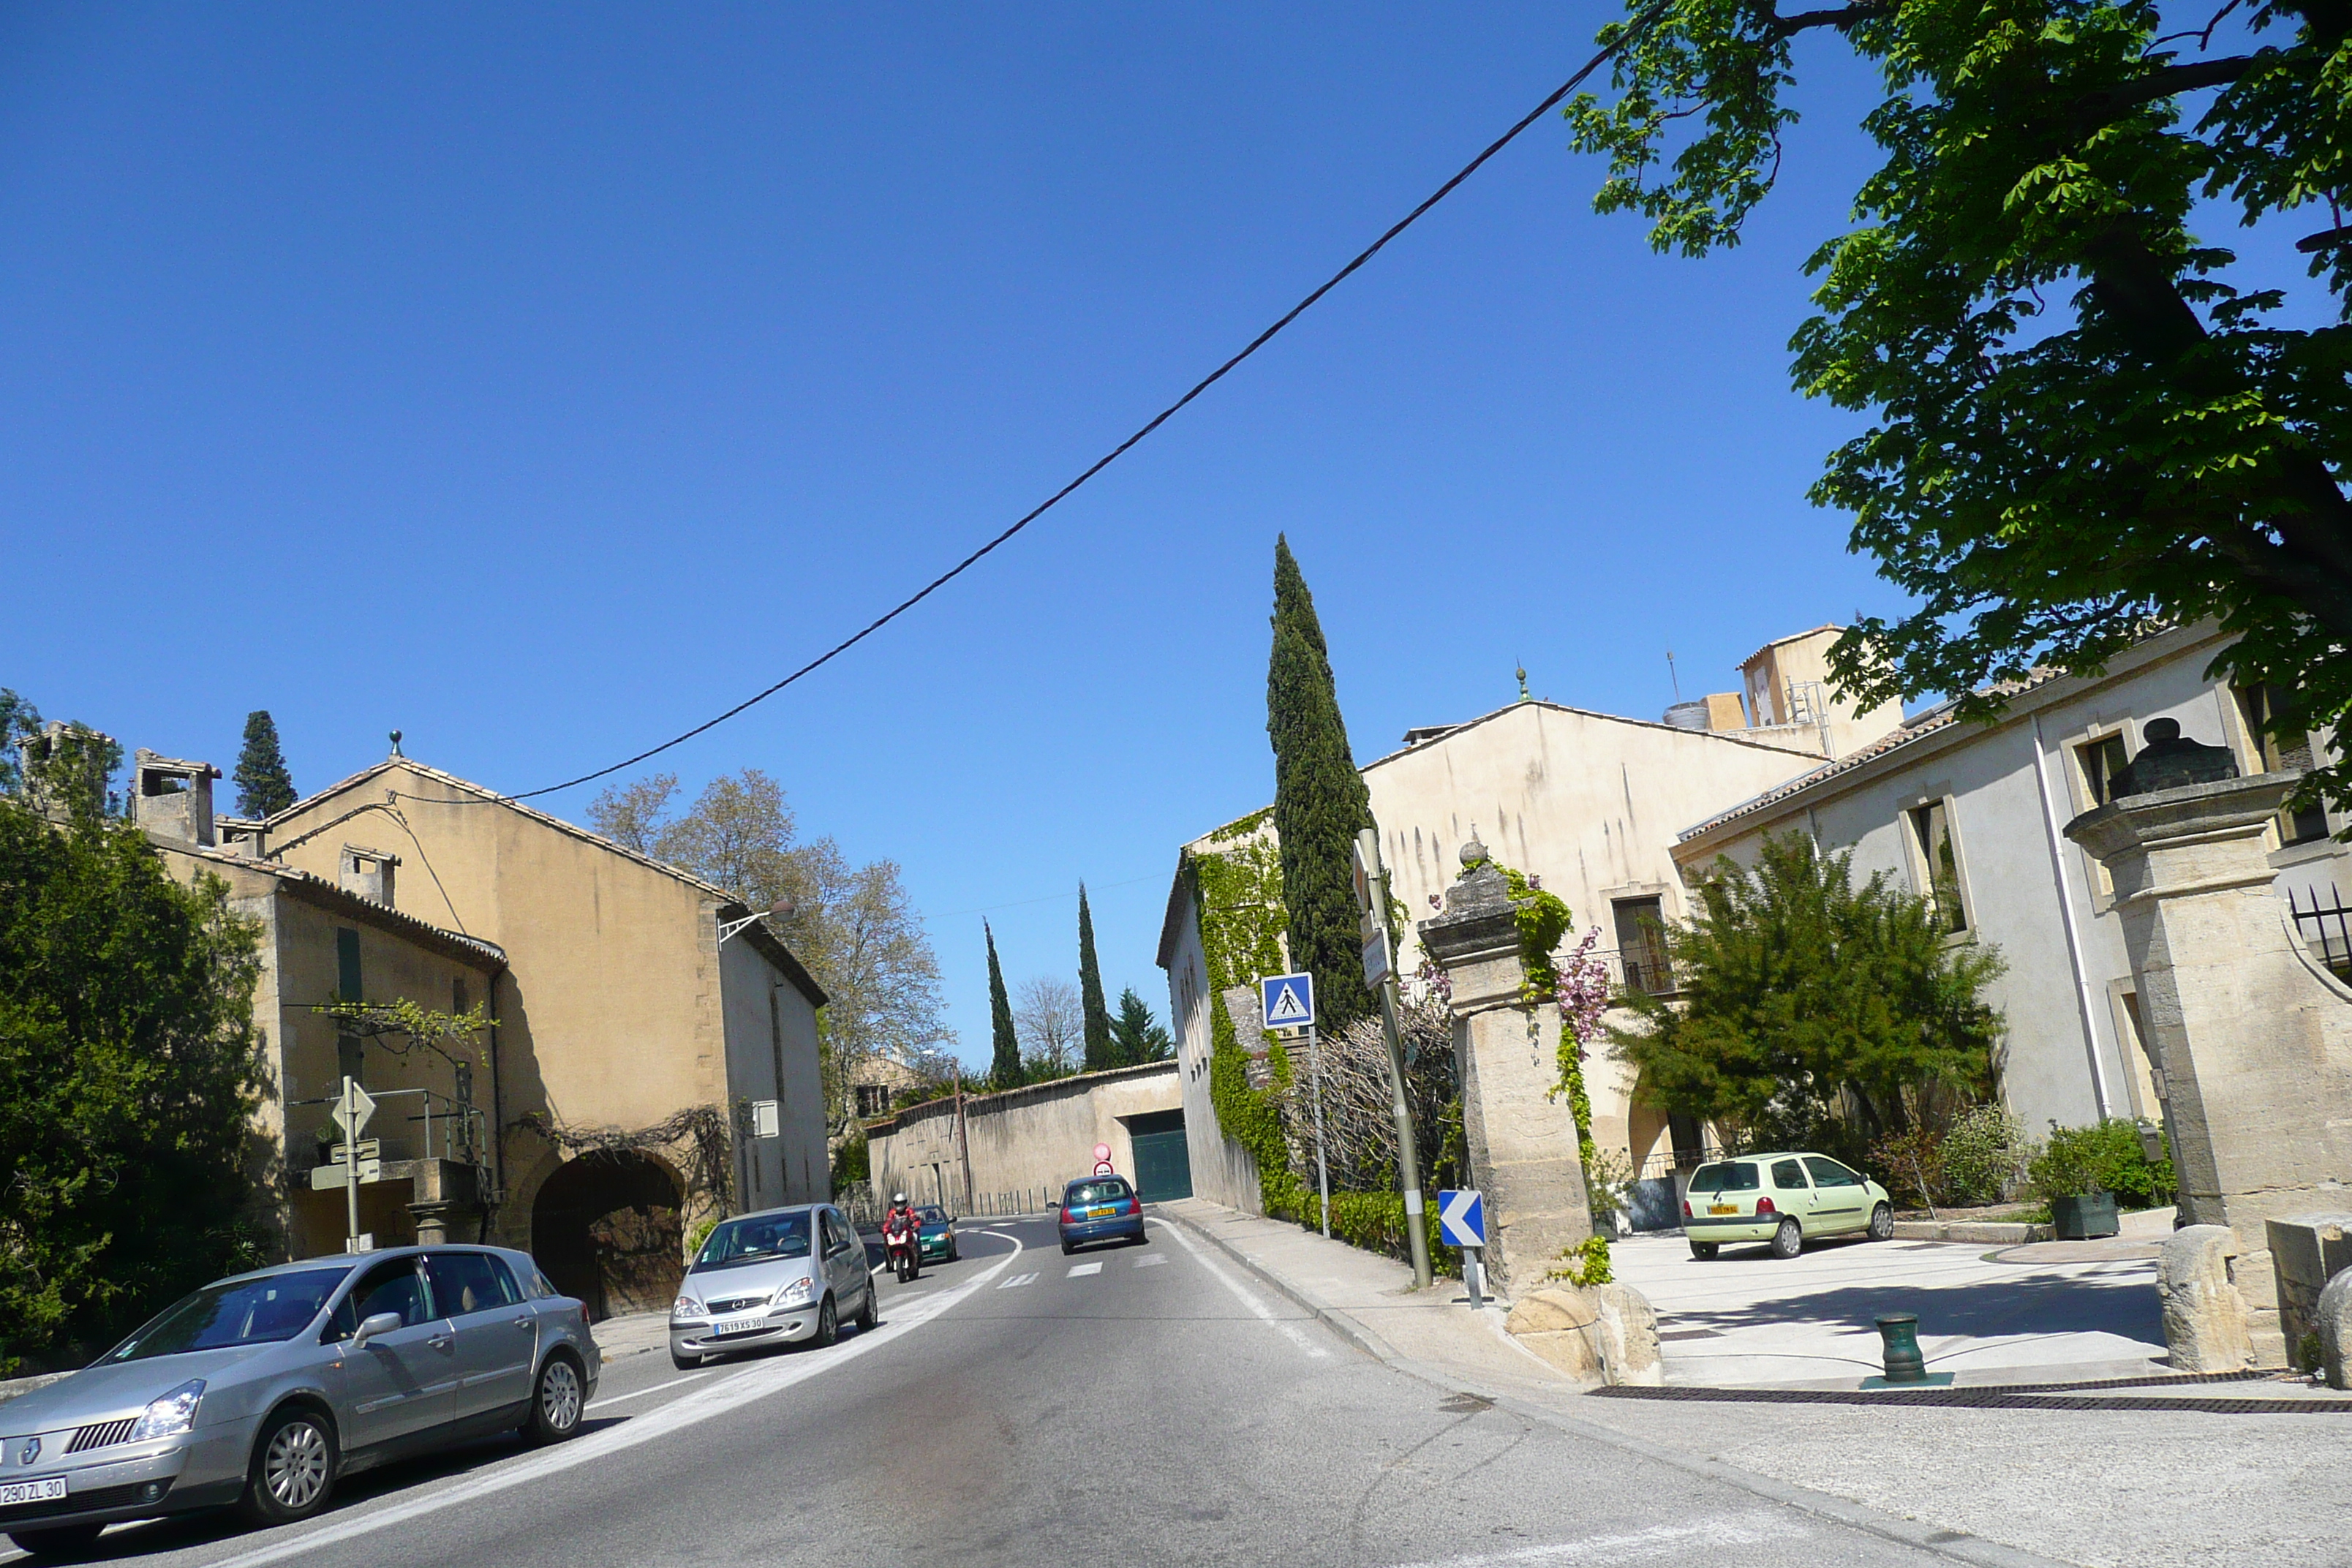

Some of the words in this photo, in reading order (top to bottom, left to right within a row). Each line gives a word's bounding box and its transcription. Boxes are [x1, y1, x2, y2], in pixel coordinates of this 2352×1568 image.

[720, 1322, 739, 1333] 7619
[740, 1321, 750, 1330] XS
[752, 1319, 761, 1327] 30
[0, 1485, 26, 1503] 290
[28, 1484, 43, 1500] ZL
[46, 1481, 61, 1496] 30
